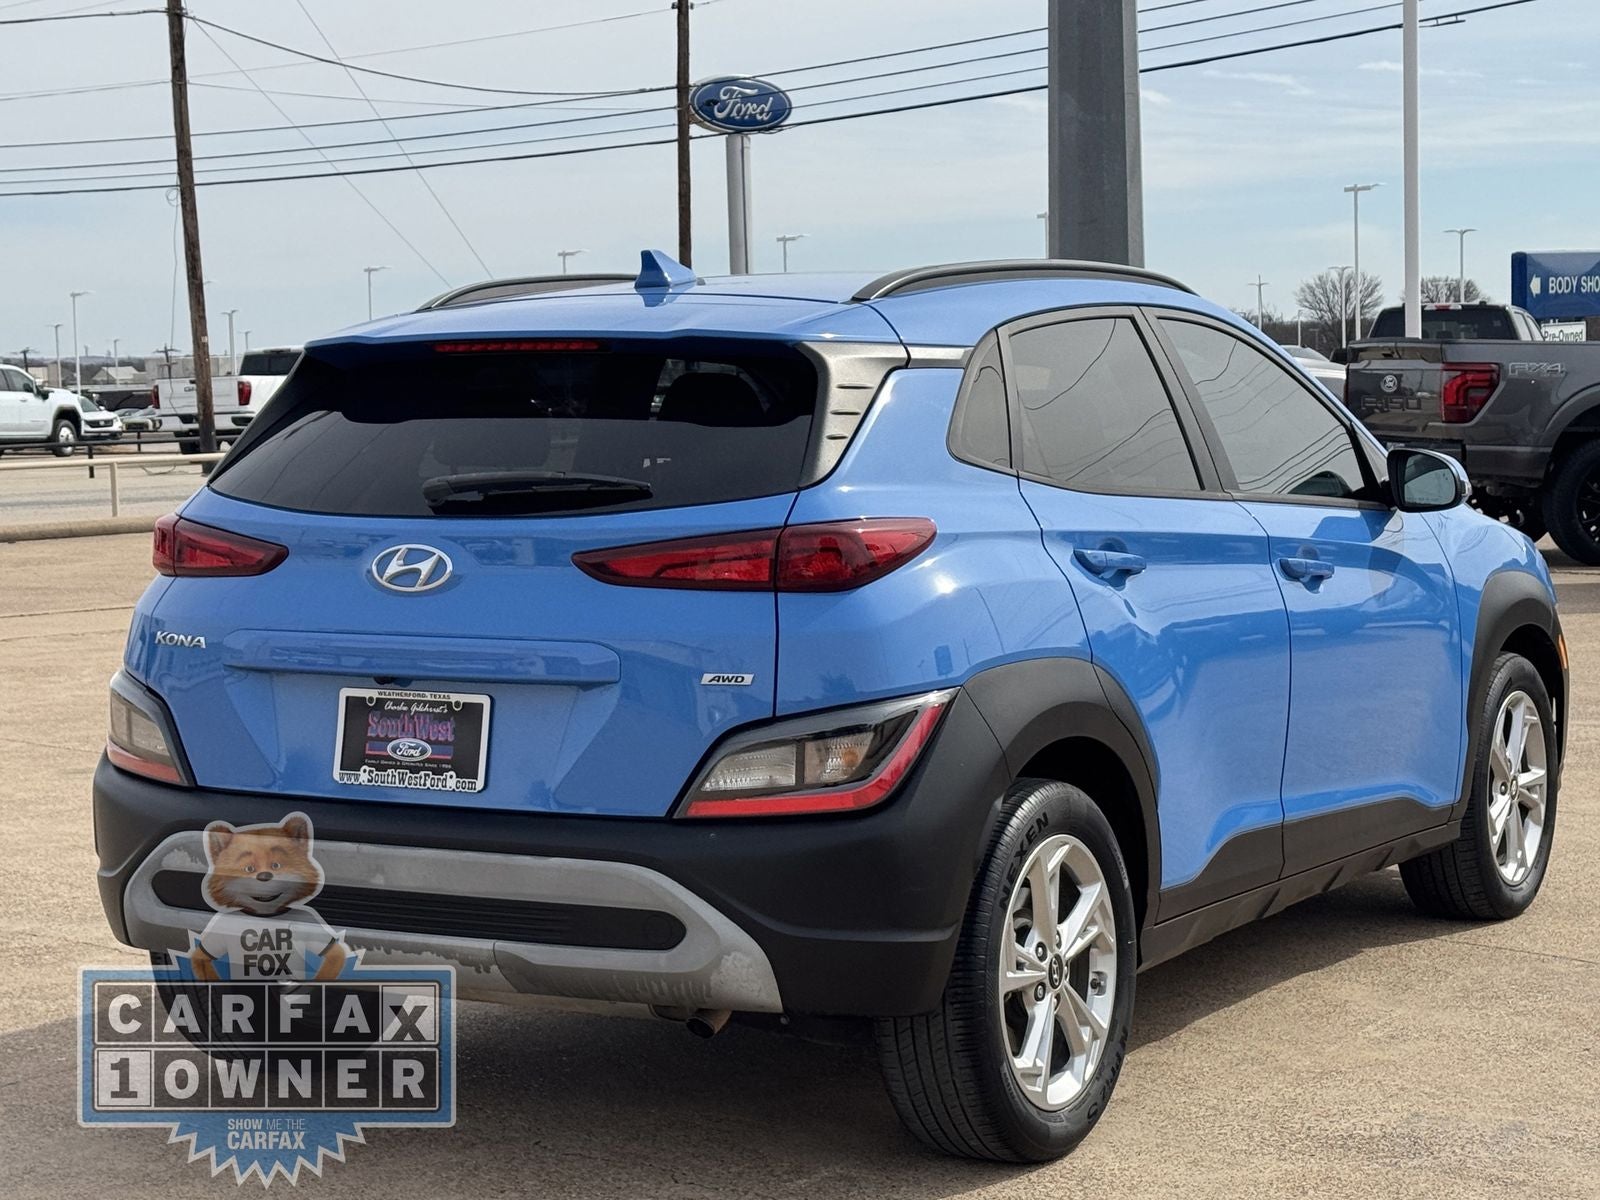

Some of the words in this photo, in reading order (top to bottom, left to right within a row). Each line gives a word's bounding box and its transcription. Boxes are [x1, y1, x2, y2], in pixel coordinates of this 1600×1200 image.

[714, 86, 773, 120] Ford
[1548, 276, 1578, 294] BODY
[1508, 362, 1563, 377] FX4
[154, 630, 206, 649] KONA
[708, 675, 745, 683] AWD
[396, 741, 422, 757] Ford
